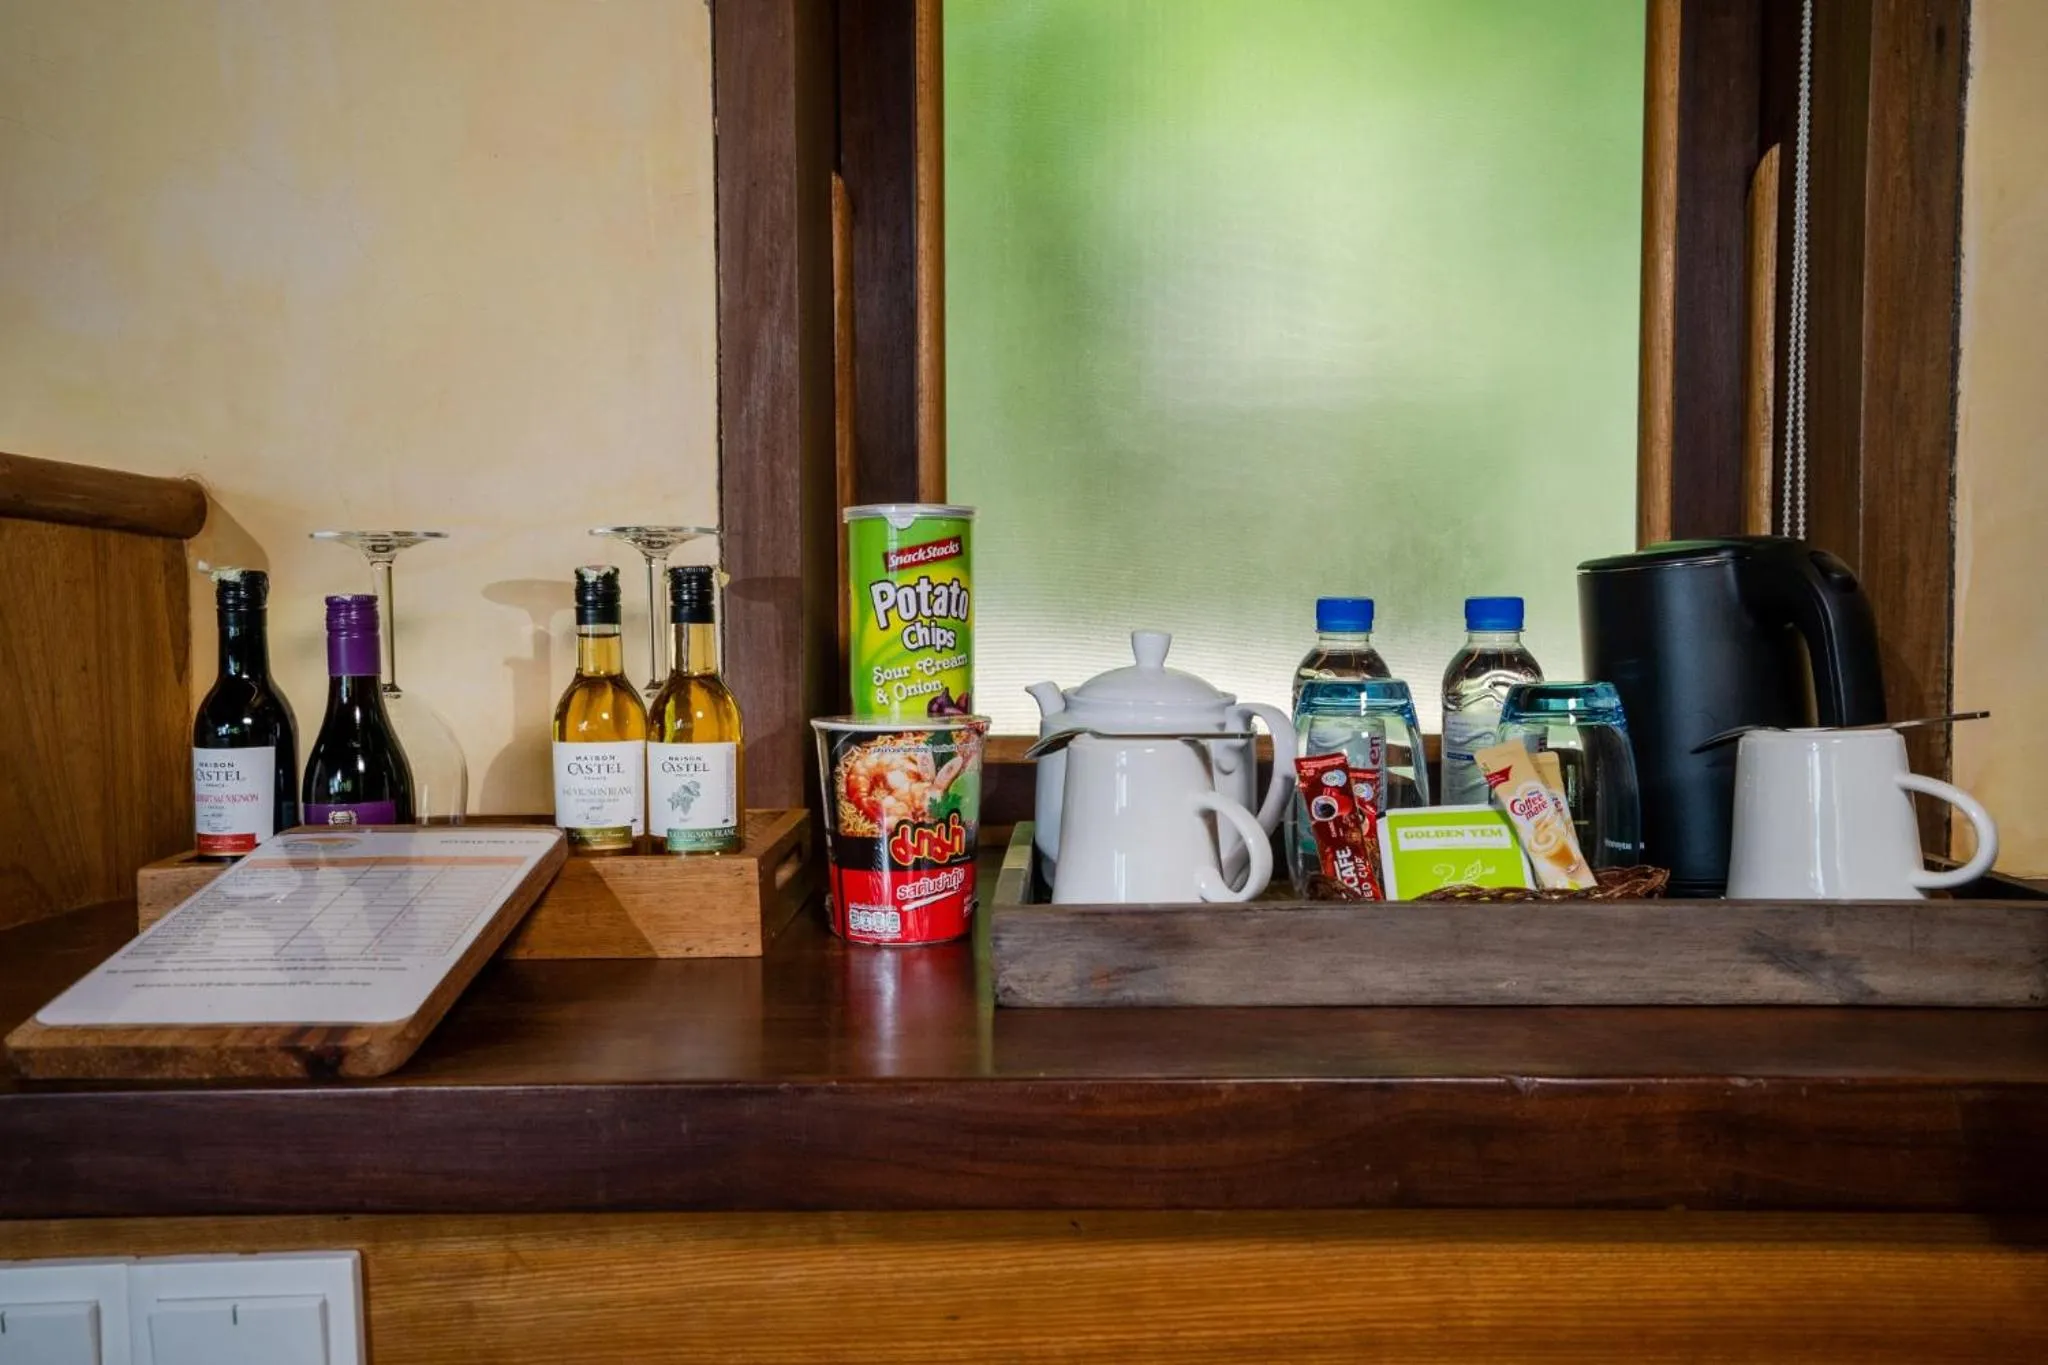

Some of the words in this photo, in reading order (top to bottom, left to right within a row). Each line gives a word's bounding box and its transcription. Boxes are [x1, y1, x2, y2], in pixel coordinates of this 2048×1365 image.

[869, 576, 969, 630] Potato
[902, 620, 956, 652] Chips
[872, 666, 910, 686] Sour
[916, 654, 968, 676] Cream
[875, 689, 889, 705] &
[893, 680, 943, 701] Onion
[567, 762, 626, 775] CASTEL
[661, 761, 712, 773] CASTEL
[1509, 793, 1543, 817] Coffee
[1525, 801, 1549, 821] mate
[1403, 829, 1465, 840] GOLDEN
